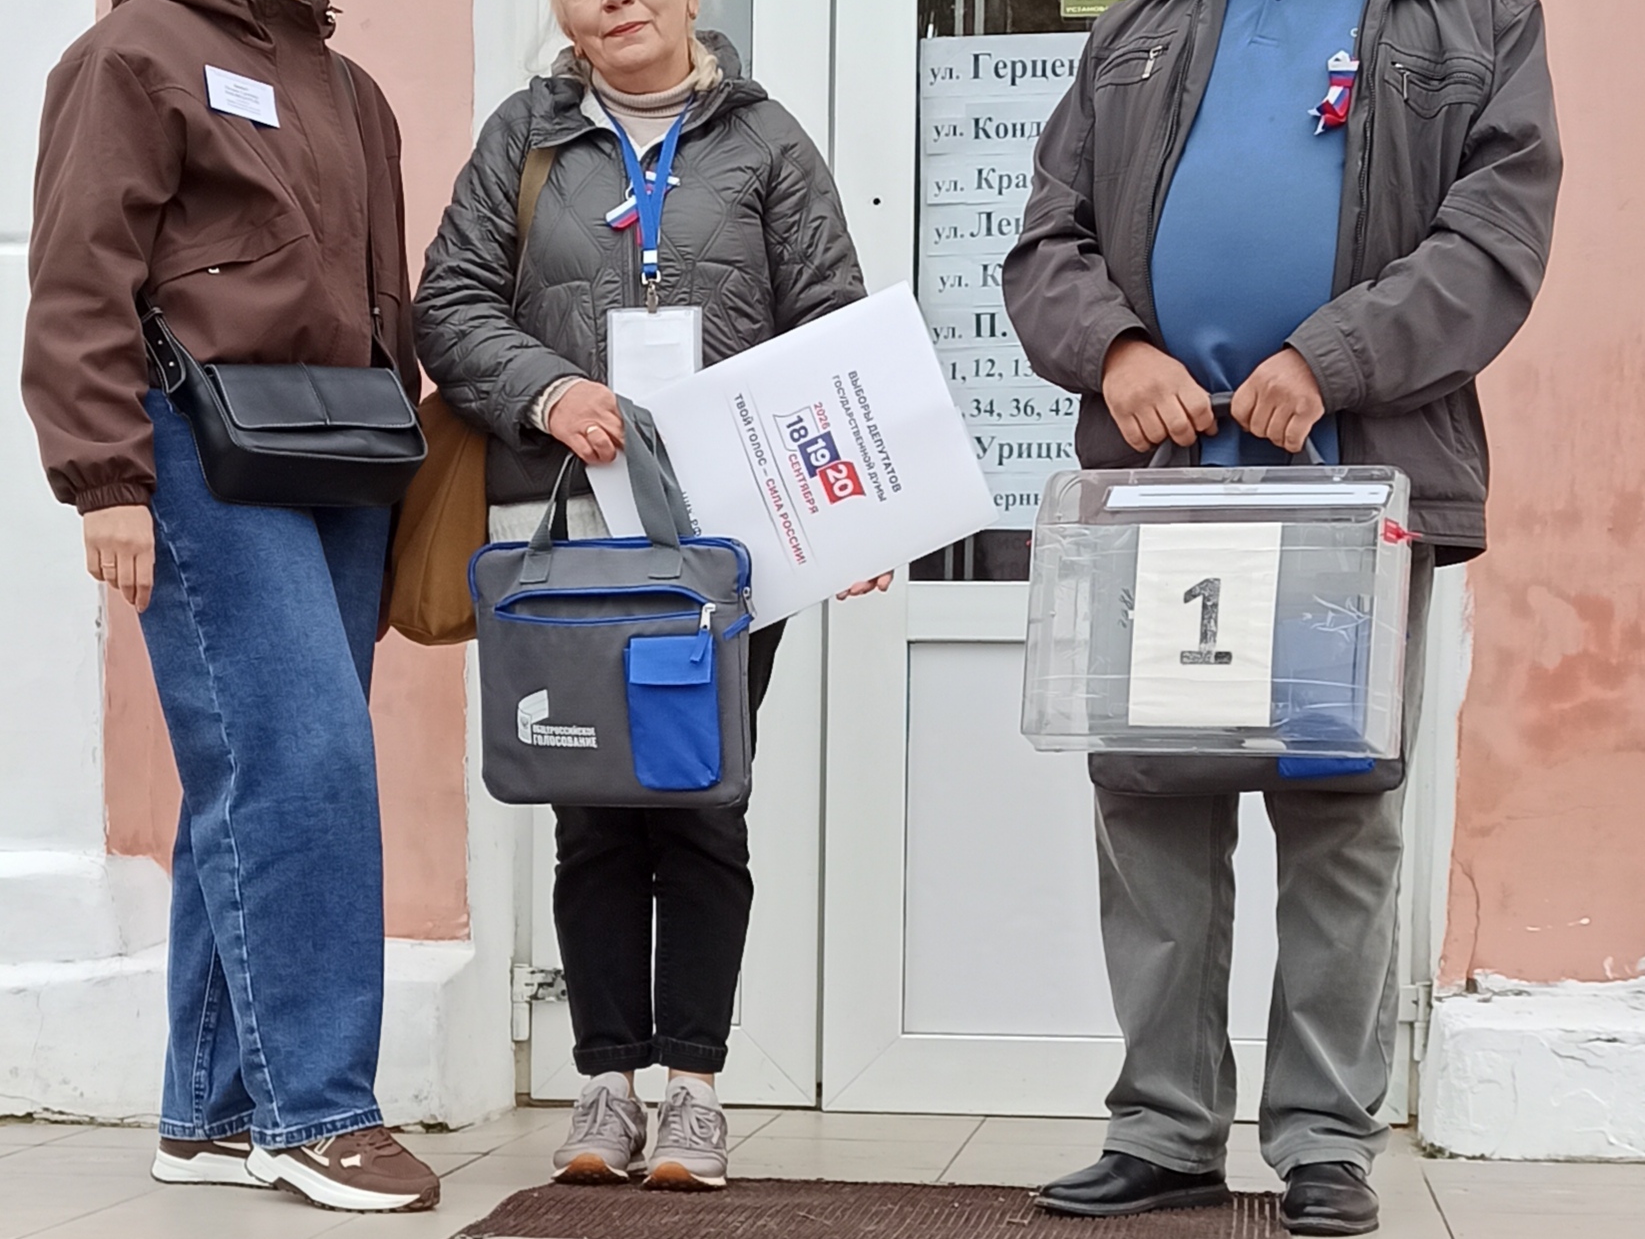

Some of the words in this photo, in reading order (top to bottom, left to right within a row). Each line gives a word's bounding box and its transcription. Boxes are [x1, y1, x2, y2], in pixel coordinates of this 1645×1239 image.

[930, 66, 960, 86] ул.
[933, 124, 964, 143] ул.
[934, 180, 965, 198] ул.
[975, 167, 1028, 196] Кра
[934, 226, 965, 245] ул.
[938, 275, 969, 293] ул.
[980, 263, 1003, 287] К
[932, 326, 962, 345] ул.
[974, 312, 1007, 338] П.
[973, 358, 1004, 380] 12,
[813, 401, 830, 430] 2026
[969, 398, 1003, 420] 34,
[1009, 397, 1043, 421] 36,
[1049, 396, 1080, 416] 42
[832, 374, 875, 471] ГОСУДАРСТВЕННОЙ
[868, 470, 887, 503] ДУМЫ
[848, 370, 875, 422] ВЫБОРЫ
[867, 422, 902, 493] ДЕПУТАТОВ
[786, 415, 809, 443] 18
[806, 438, 831, 467] 19
[825, 464, 854, 498] 20
[973, 435, 1074, 466] Урицк
[734, 393, 754, 426] ТВОЙ
[746, 424, 768, 467] ГОЛОС
[765, 478, 784, 512] СИЛА
[779, 512, 807, 565] РОССИИ!
[788, 453, 819, 514] СЕНТЯБРЯ
[993, 492, 1041, 512] ерн
[1180, 578, 1232, 665] 1
[532, 734, 598, 748] ГОЛОСОВАНИЕ
